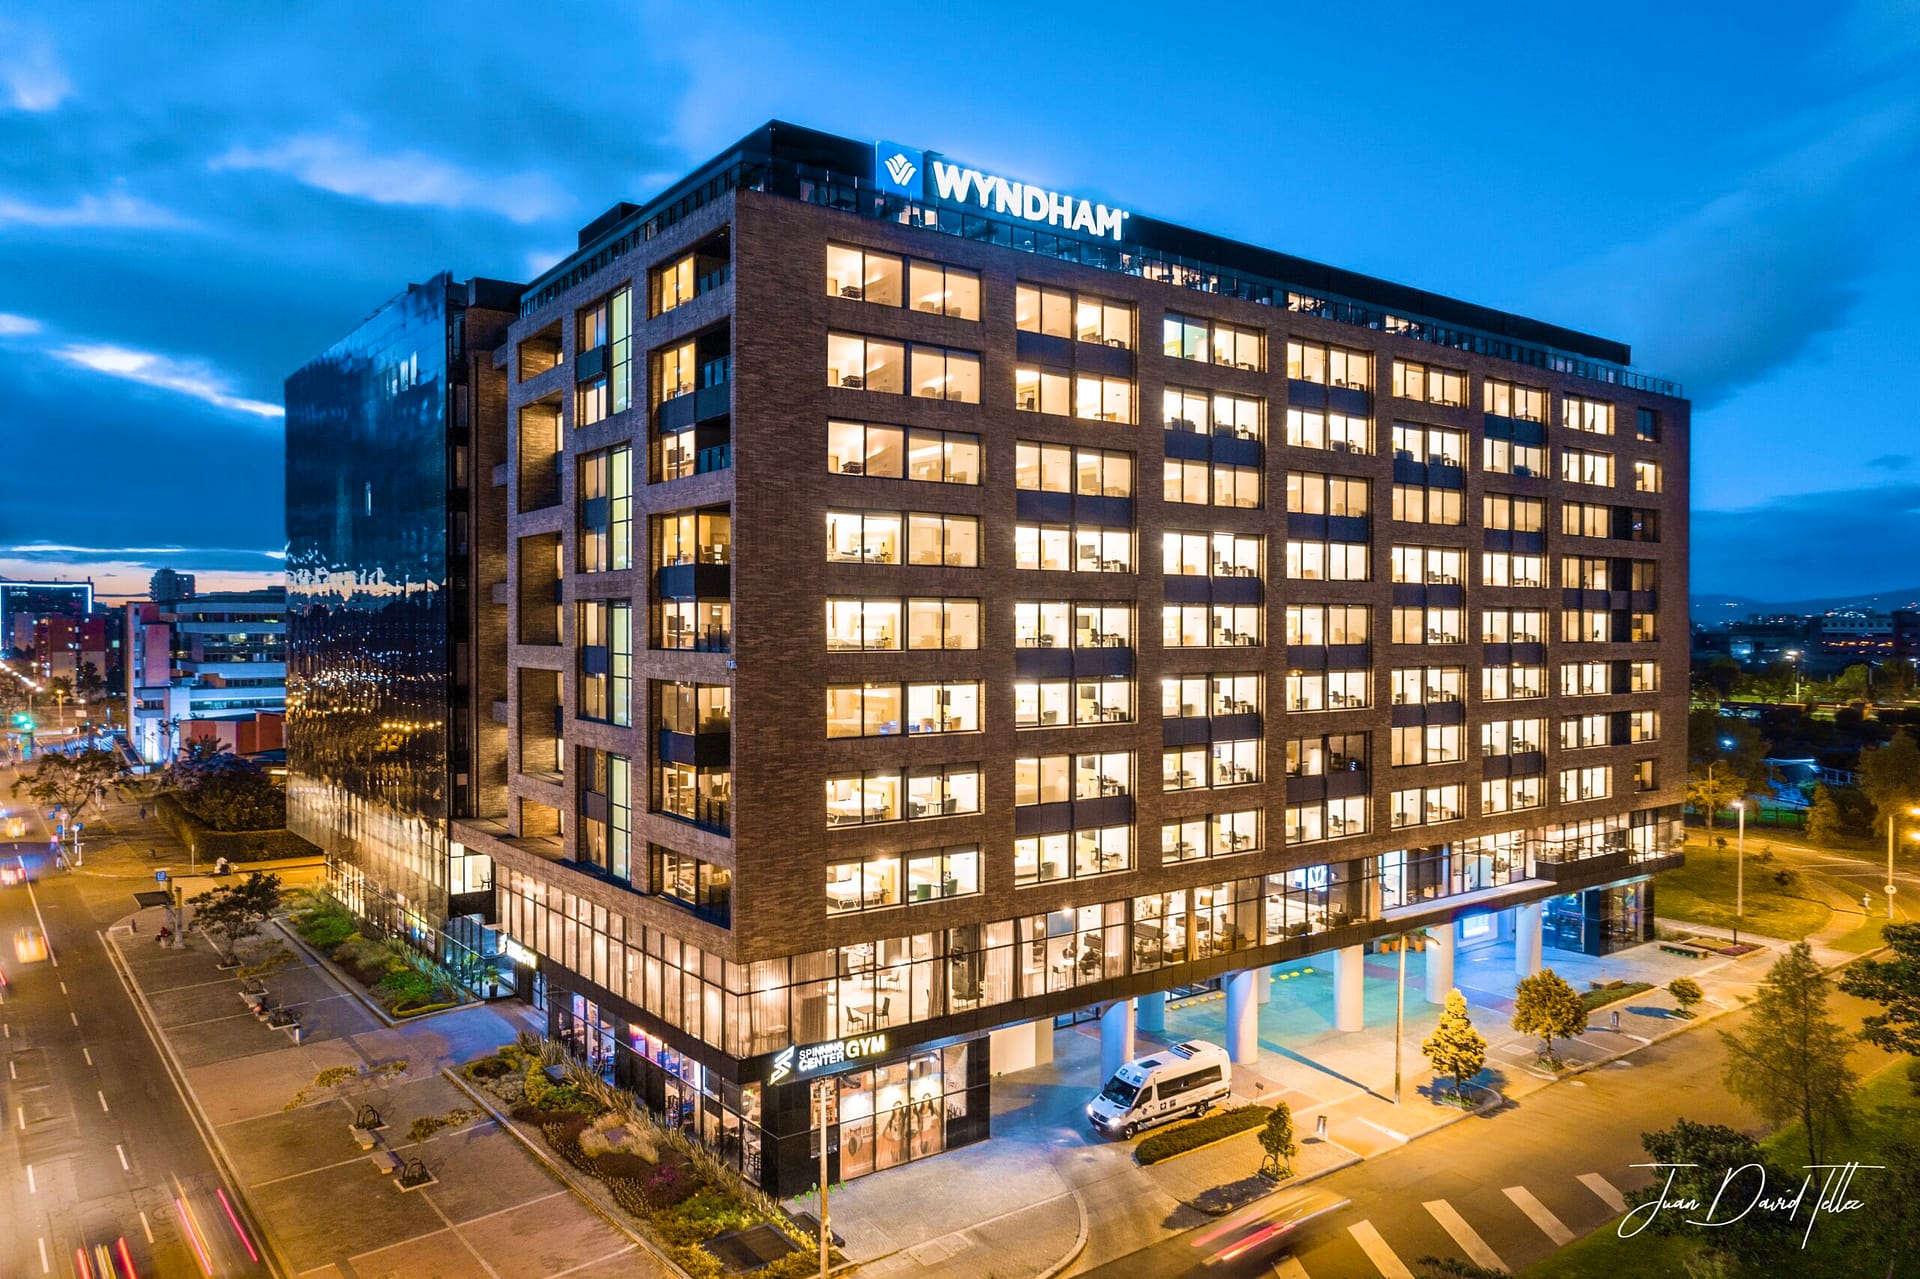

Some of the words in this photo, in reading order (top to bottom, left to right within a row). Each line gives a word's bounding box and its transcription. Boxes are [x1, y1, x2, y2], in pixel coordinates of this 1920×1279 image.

[932, 161, 1123, 241] WYNDHAM
[799, 1041, 845, 1060] SPINNING
[846, 1034, 886, 1058] GYM
[798, 1051, 845, 1071] CENTER
